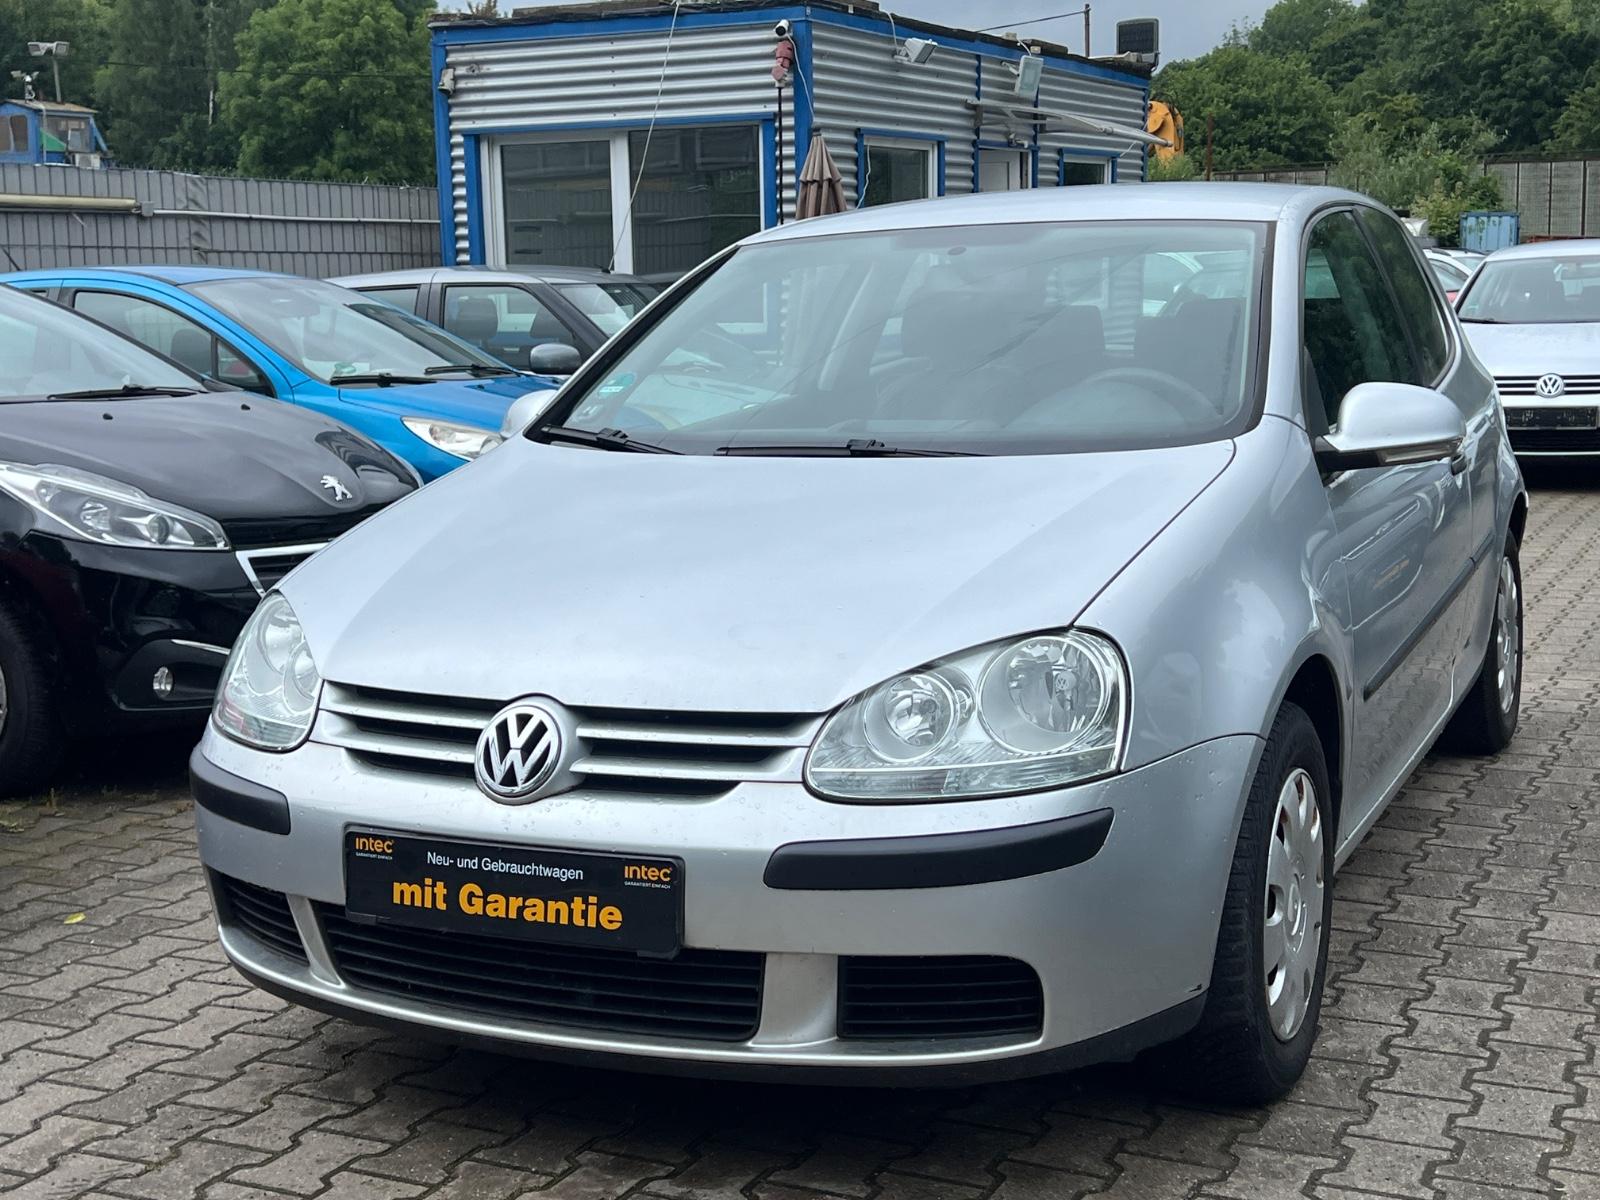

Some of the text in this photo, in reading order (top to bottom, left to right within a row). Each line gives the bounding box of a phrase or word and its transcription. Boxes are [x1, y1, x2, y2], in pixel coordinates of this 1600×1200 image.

[1536, 373, 1564, 398] VW
[476, 702, 561, 797] VW
[427, 851, 584, 882] Neu- und Gebrauchtwagen
[392, 878, 623, 930] mit Garantie
